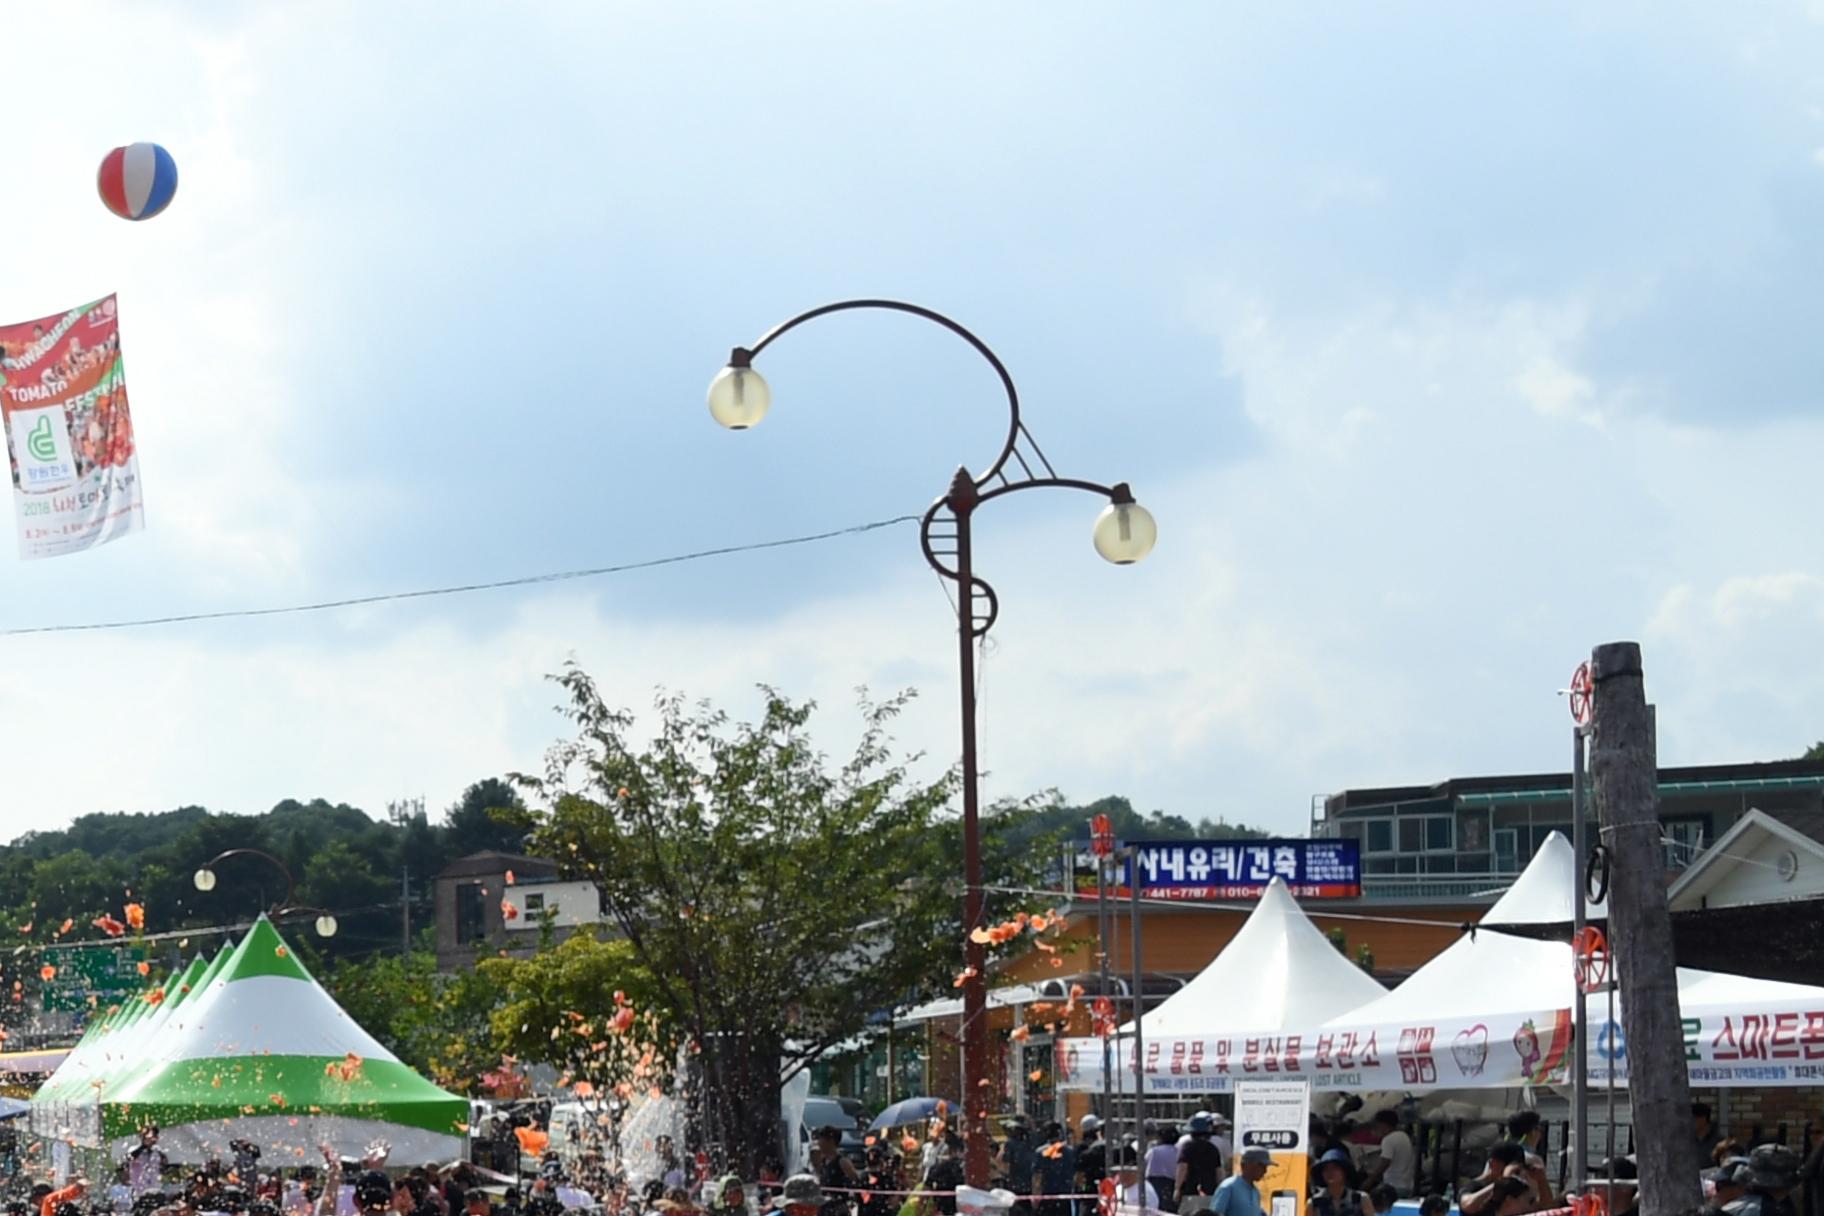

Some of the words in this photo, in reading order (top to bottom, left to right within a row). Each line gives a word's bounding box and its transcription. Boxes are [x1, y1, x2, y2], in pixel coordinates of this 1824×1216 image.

[1170, 1040, 1204, 1075] 물품
[1216, 1038, 1232, 1073] 및
[1242, 1035, 1302, 1073] 분실물
[1315, 1029, 1381, 1070] 보관소
